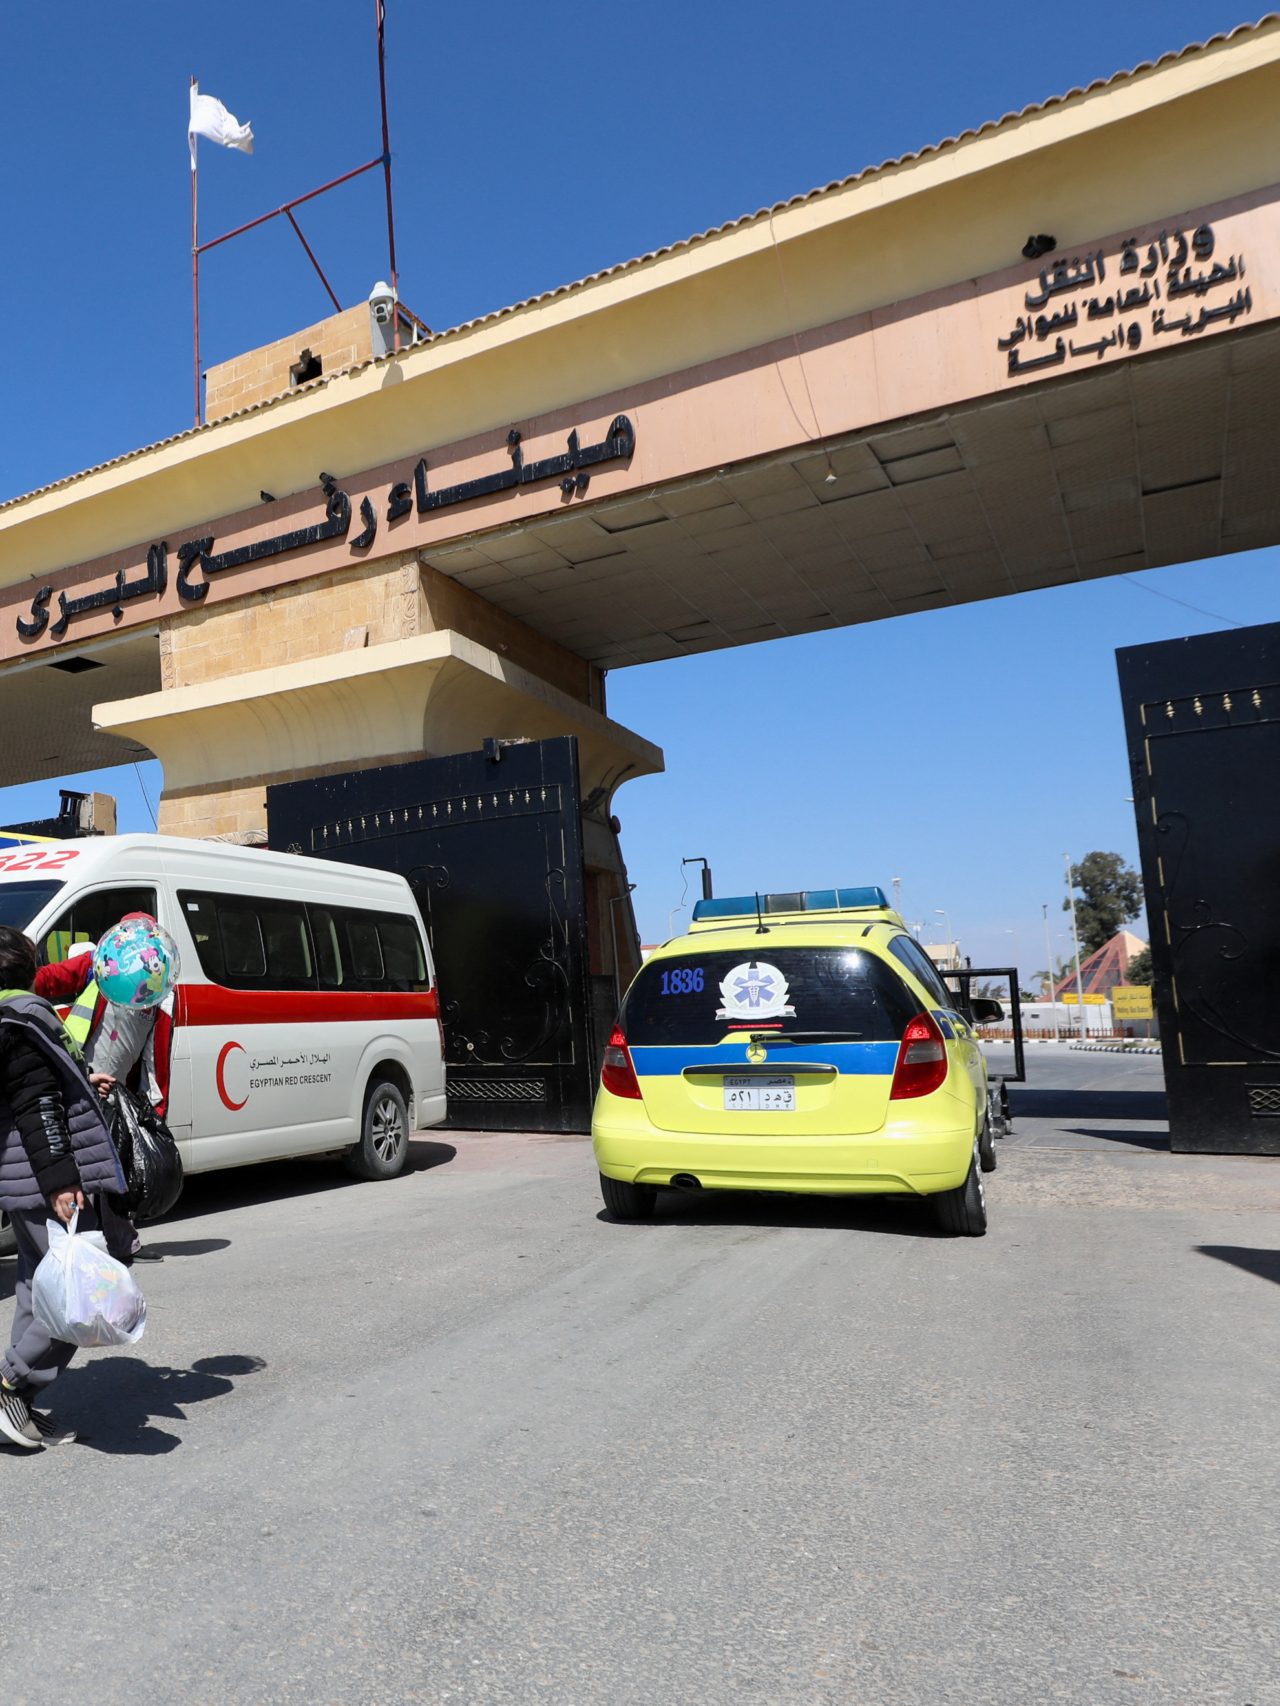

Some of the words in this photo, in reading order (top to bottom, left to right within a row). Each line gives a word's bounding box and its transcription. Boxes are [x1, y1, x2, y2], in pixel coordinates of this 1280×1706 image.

[1120, 224, 1215, 277] وزارة
[1025, 249, 1106, 310] النقل
[387, 414, 635, 523] ميناء
[177, 483, 377, 602] رفح
[661, 967, 705, 995] 1836
[250, 1078, 284, 1089] EGYPTIAN
[285, 1076, 299, 1086] RED
[300, 1073, 332, 1085] CRESCENT
